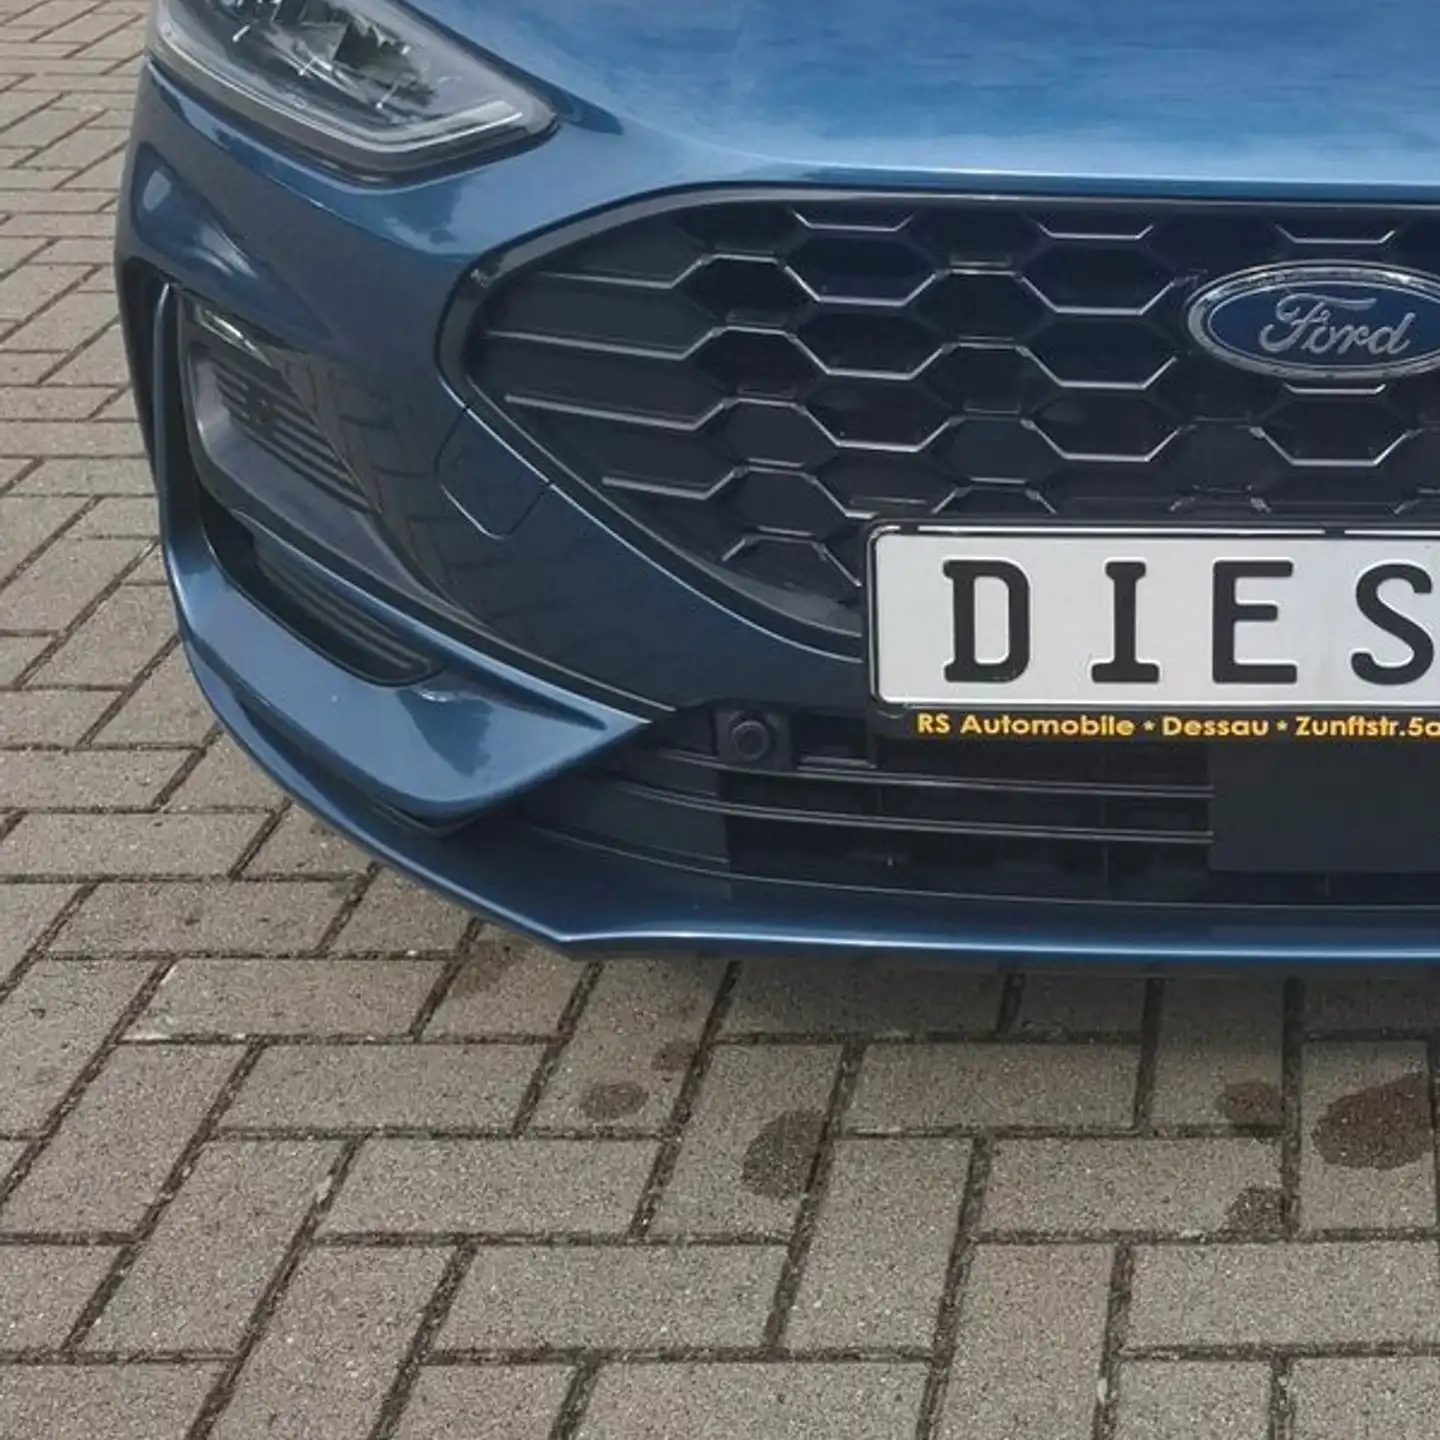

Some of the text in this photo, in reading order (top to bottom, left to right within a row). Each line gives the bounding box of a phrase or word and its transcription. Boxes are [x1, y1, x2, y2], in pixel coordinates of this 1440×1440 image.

[1258, 292, 1417, 354] Ford
[917, 712, 950, 735] RS
[959, 713, 1136, 737] Automobile
[1162, 716, 1269, 737] Dessau
